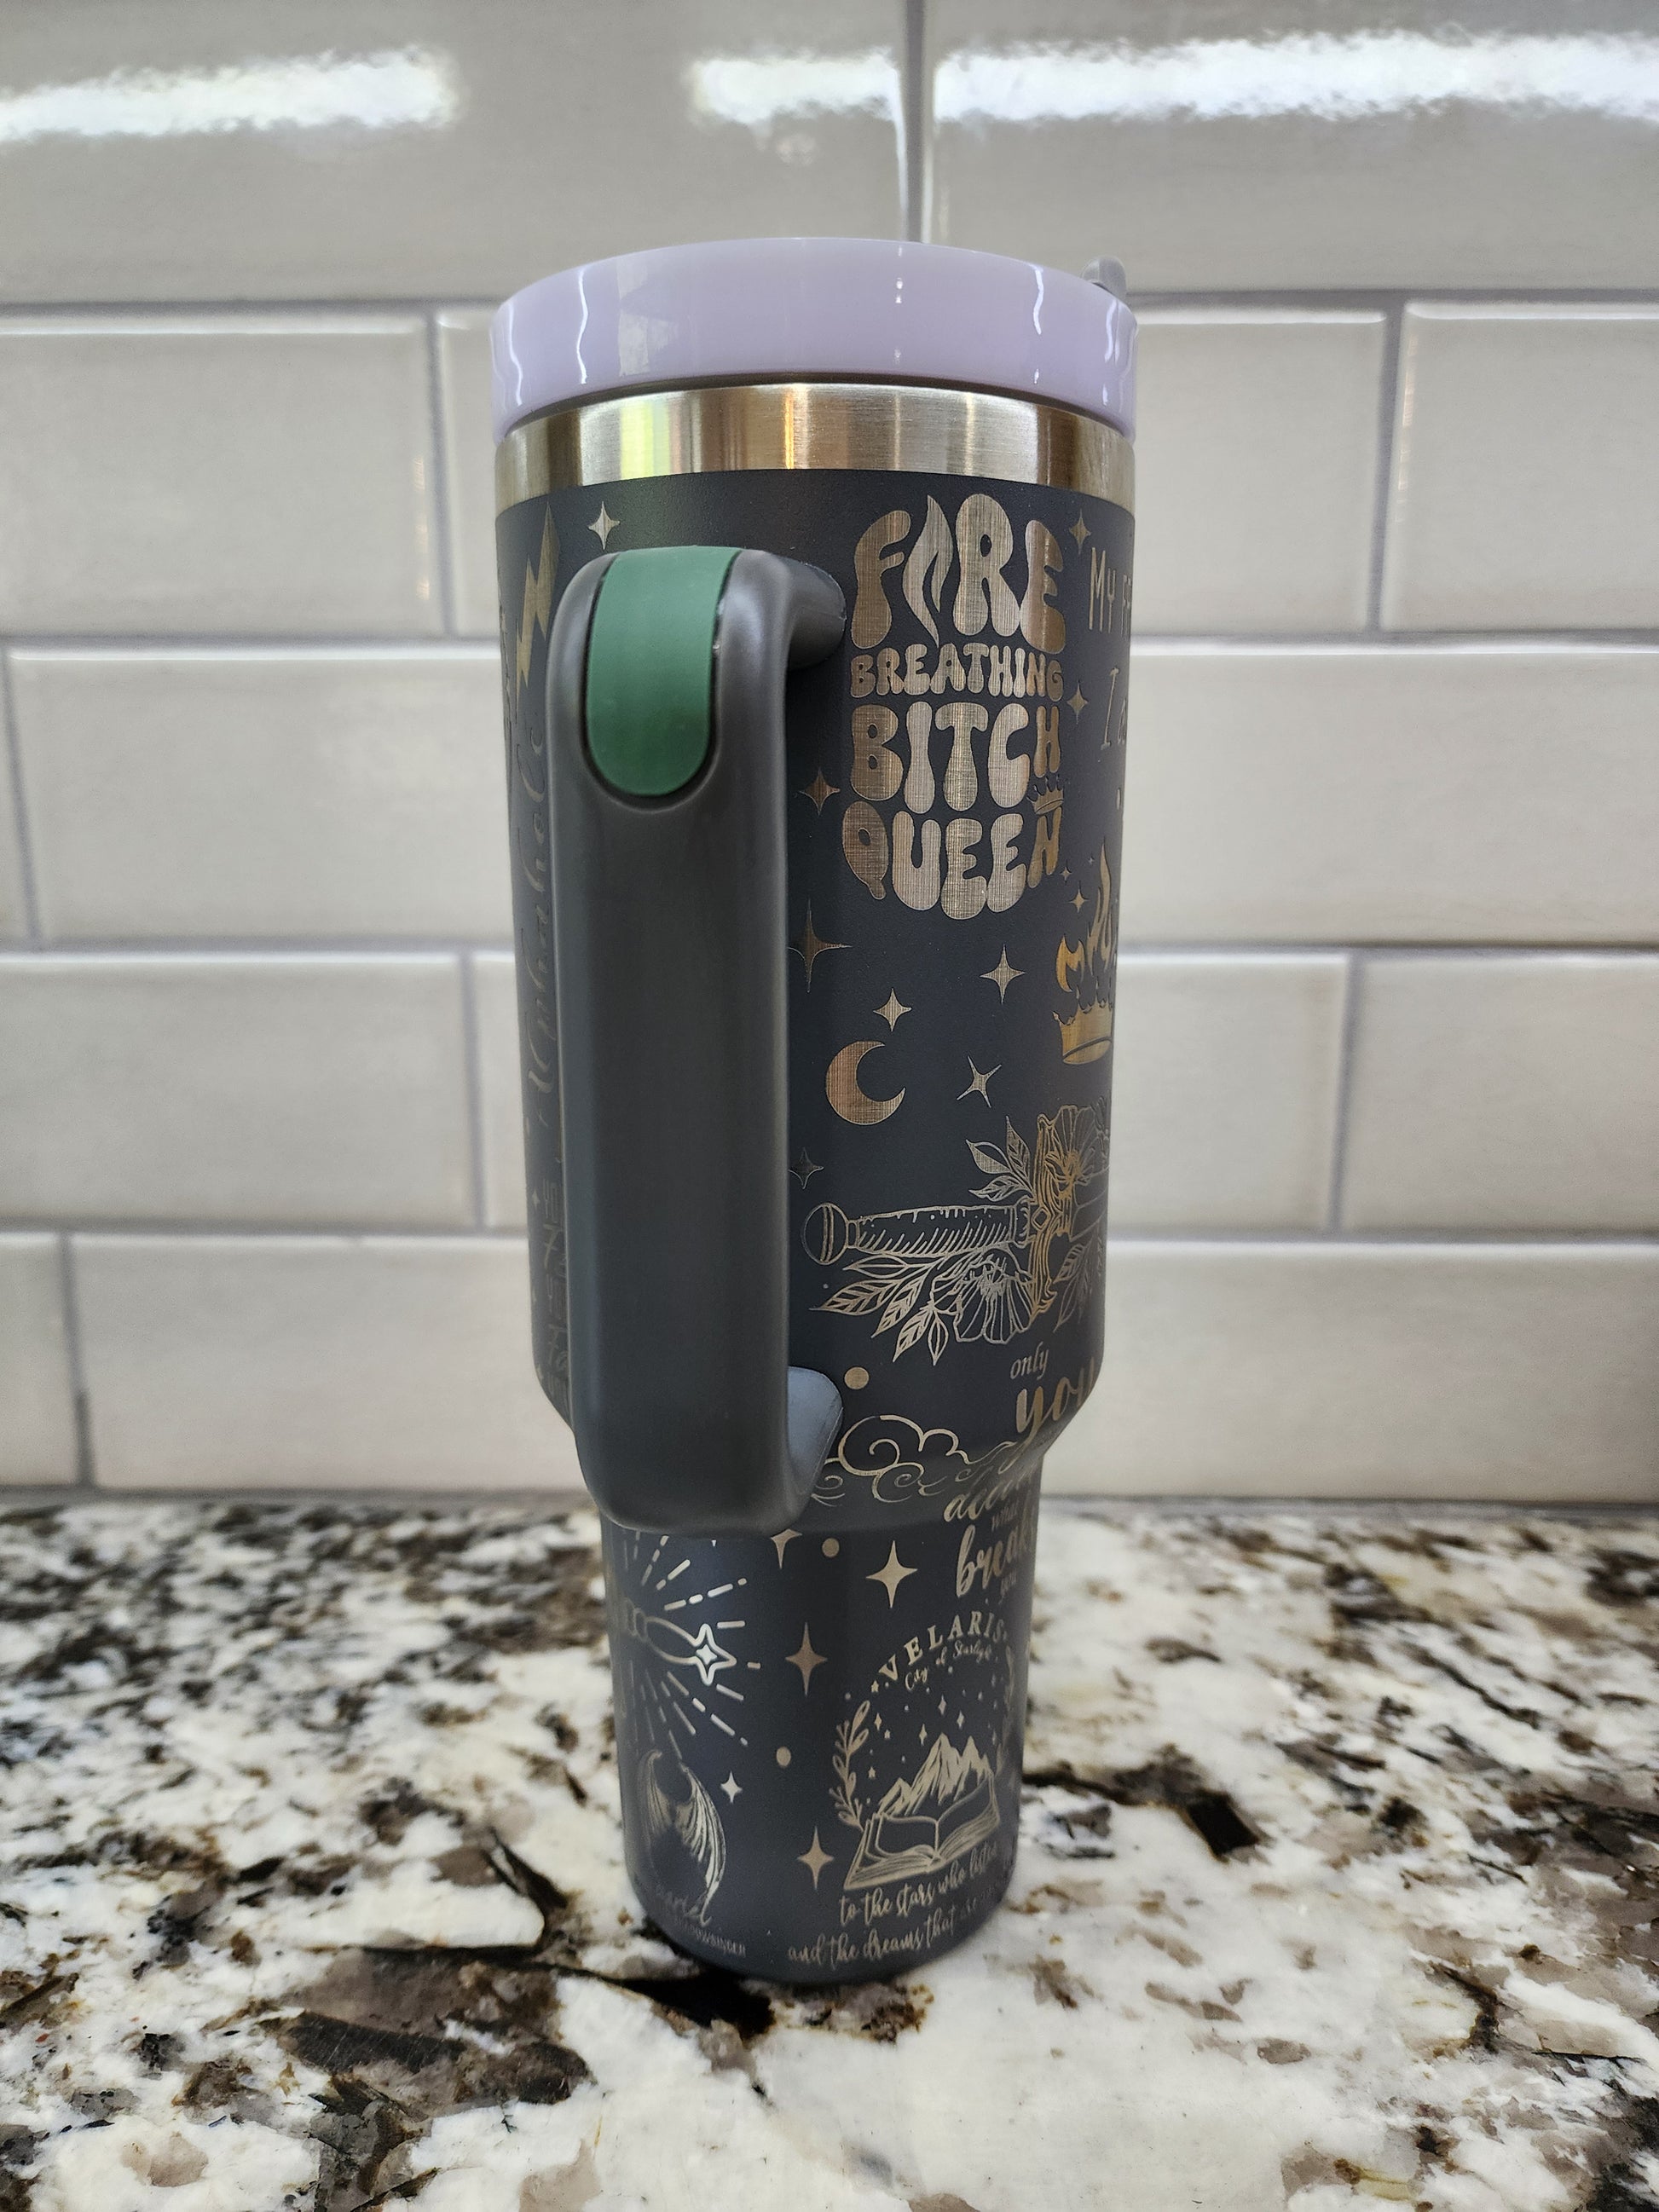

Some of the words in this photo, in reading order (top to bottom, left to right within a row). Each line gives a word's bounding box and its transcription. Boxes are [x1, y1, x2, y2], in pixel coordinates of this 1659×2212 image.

[850, 643, 1064, 702] BREATHING
[850, 702, 1062, 814] BITCH
[842, 800, 1063, 921] QUEEN
[1009, 1341, 1049, 1380] only
[997, 1355, 1096, 1475] you
[879, 1610, 1004, 1683] VELARIS
[839, 1894, 857, 1926] to
[862, 1887, 893, 1926] the
[896, 1882, 935, 1918] stars
[938, 1861, 966, 1895] who
[788, 1931, 826, 1967] and
[830, 1931, 859, 1971] the
[863, 1927, 924, 1961] dreams
[924, 1904, 957, 1949] that
